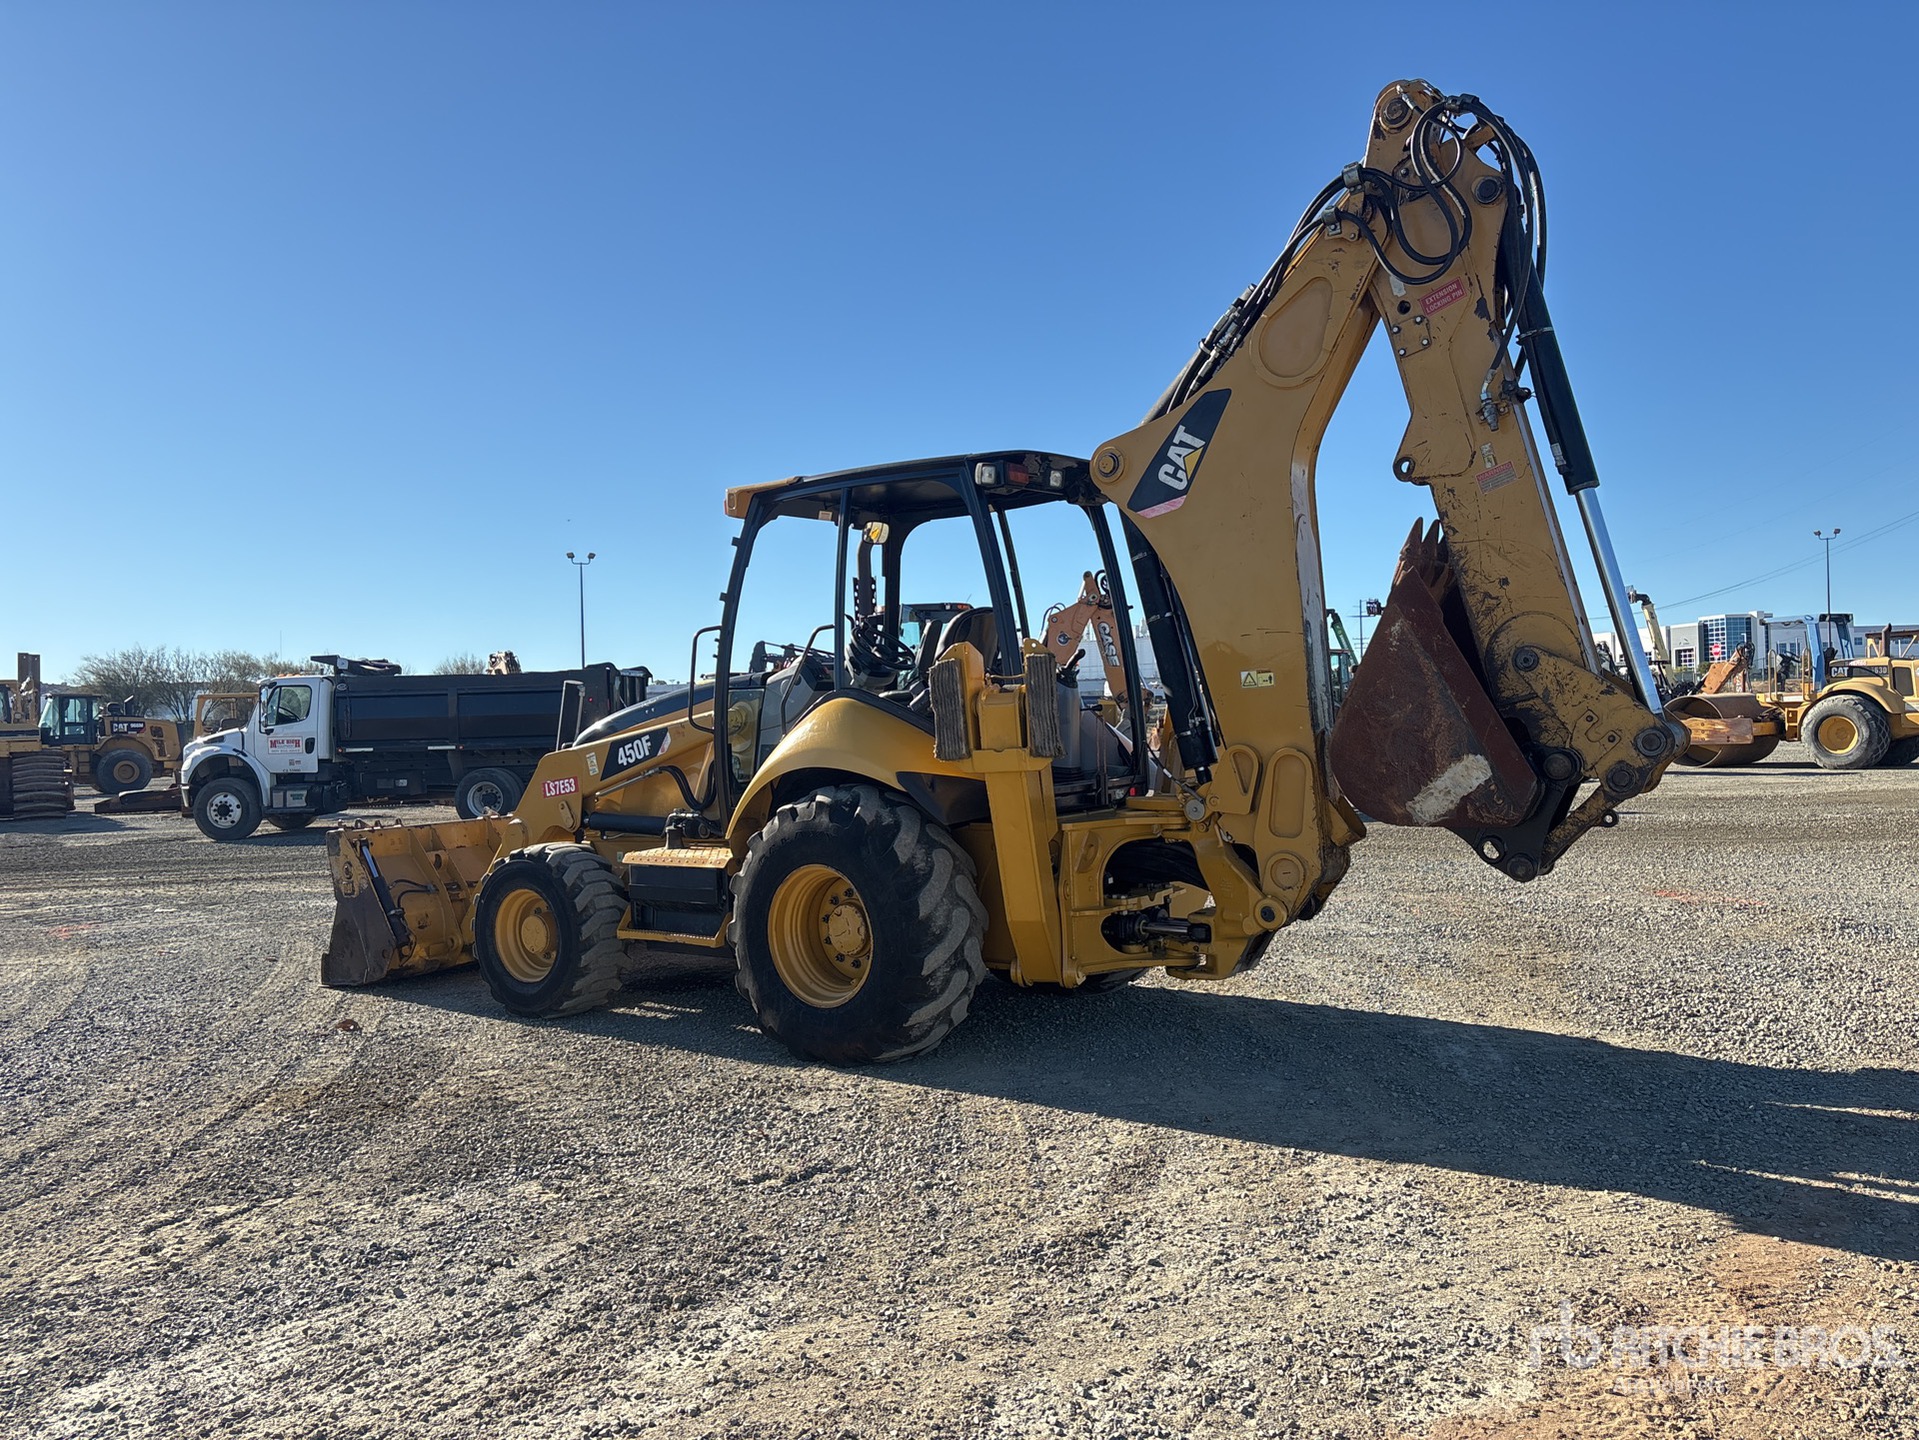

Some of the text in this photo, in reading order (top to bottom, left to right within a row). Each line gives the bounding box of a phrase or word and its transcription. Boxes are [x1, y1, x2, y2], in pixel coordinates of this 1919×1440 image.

[1424, 283, 1458, 305] EXTENSION
[1425, 289, 1463, 313] LOCKING PIN
[1158, 425, 1206, 491] CAT
[1477, 462, 1512, 481] WARNING
[1097, 621, 1120, 667] CASE
[1831, 666, 1850, 677] CAT
[112, 722, 128, 732] CAT
[617, 735, 651, 766] 450F
[544, 778, 576, 797] LS7E53
